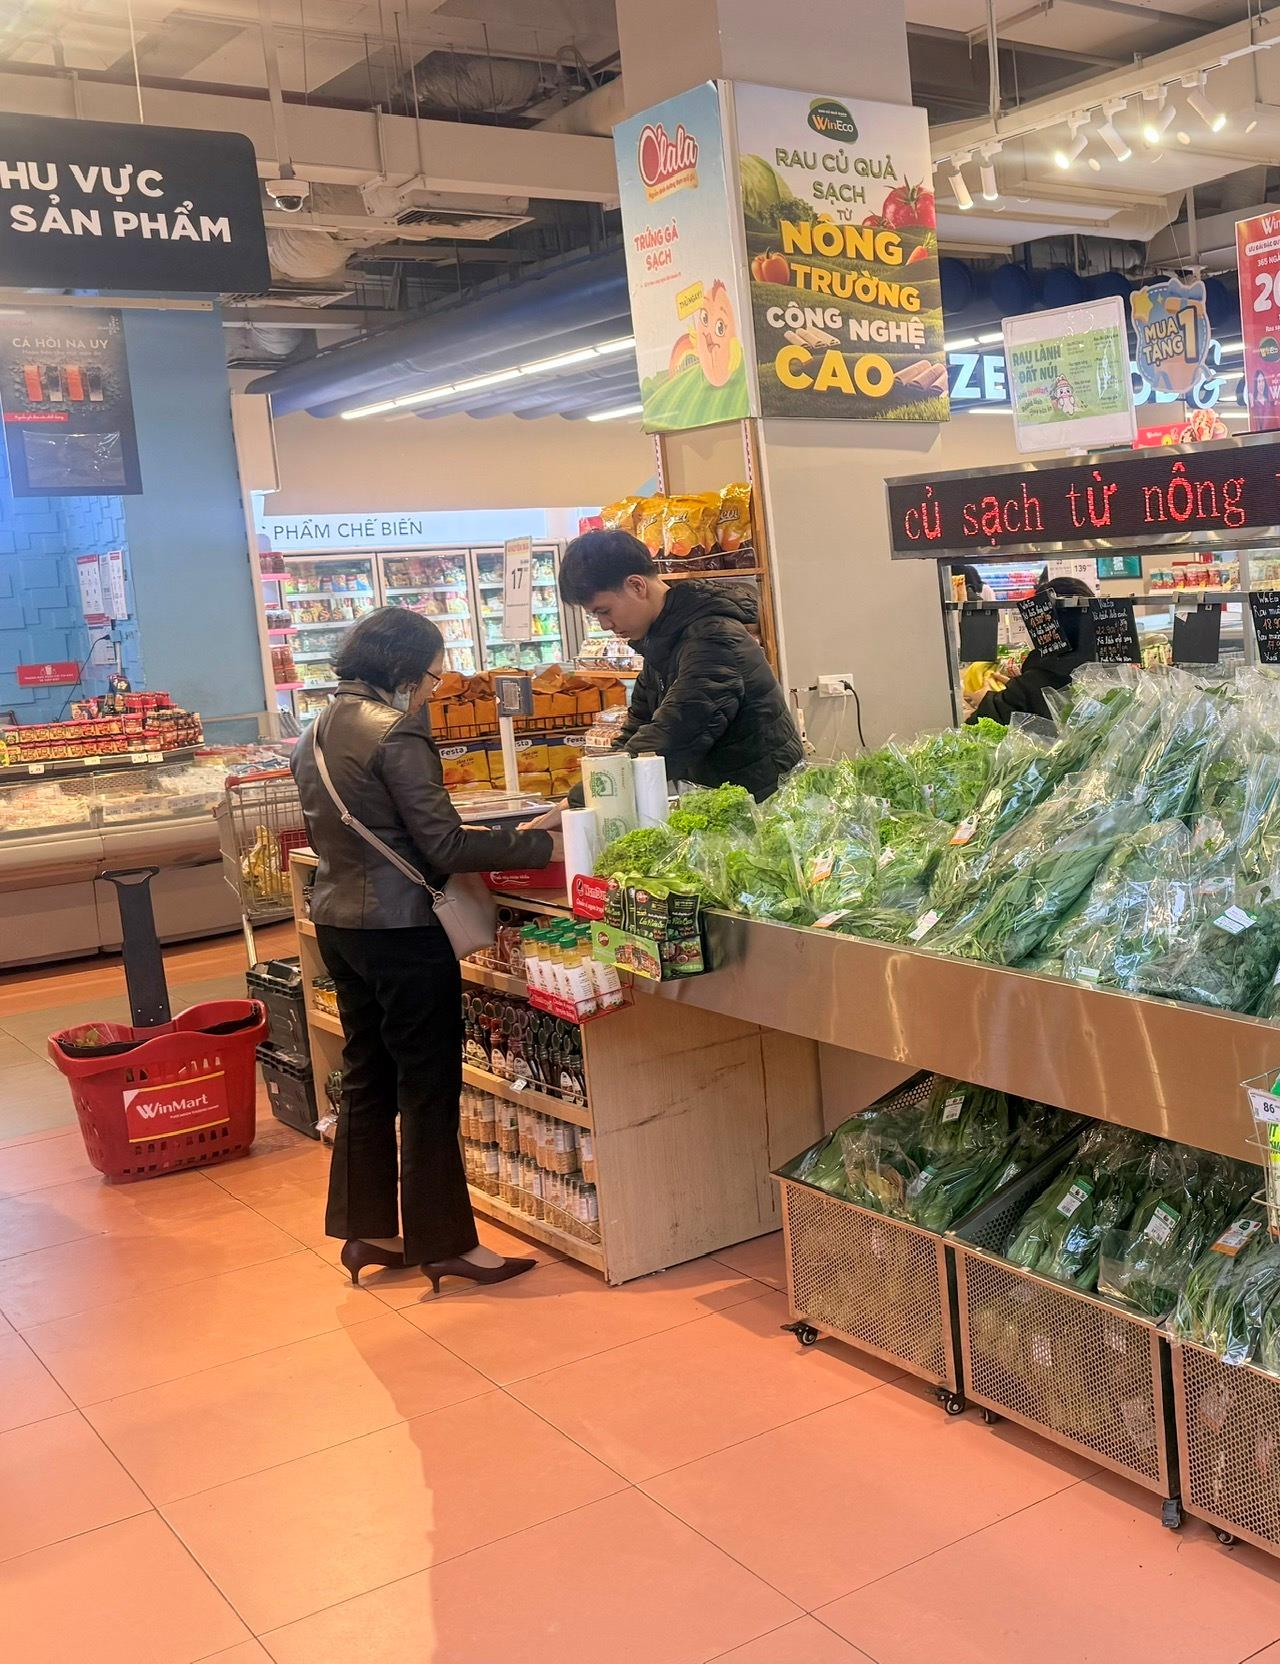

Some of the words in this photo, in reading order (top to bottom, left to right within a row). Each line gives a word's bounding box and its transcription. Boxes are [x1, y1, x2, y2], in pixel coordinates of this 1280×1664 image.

[812, 114, 853, 133] WinEco
[776, 148, 817, 171] RAU
[822, 148, 850, 174] CỦ
[854, 154, 898, 181] QUẢ
[0, 160, 58, 190] HU
[69, 164, 164, 203] VỰC
[812, 180, 866, 205] SẠCH
[10, 194, 102, 236] SẢN
[116, 200, 232, 243] PHẨM
[837, 207, 853, 221] TỪ
[634, 223, 664, 252] TRỨNG
[665, 216, 679, 246] GÀ
[779, 213, 904, 265] NÔNG
[646, 249, 672, 271] SẠCH
[1257, 258, 1268, 267] 365
[790, 263, 921, 312] TRƯỜNG
[766, 302, 842, 329] CÔNG
[849, 317, 926, 349] NGHỆ
[1143, 315, 1180, 345] MUA
[1179, 304, 1200, 364] 1
[66, 339, 86, 349] NA
[90, 339, 108, 349] UY
[1012, 350, 1033, 367] RAU
[1035, 343, 1061, 361] LÀNH
[1143, 337, 1184, 368] TẶNG
[775, 344, 896, 398] CAO
[1018, 365, 1038, 384] ĐẤT
[1040, 362, 1059, 380] NÚI
[905, 486, 942, 541] củ
[962, 483, 1044, 547] sạch
[1065, 470, 1118, 528] từ
[1144, 462, 1246, 528] nông
[273, 519, 330, 541] PHẨM
[338, 518, 378, 539] CHẾ
[382, 516, 423, 537] BIẾN
[136, 1093, 208, 1119] WinMart
